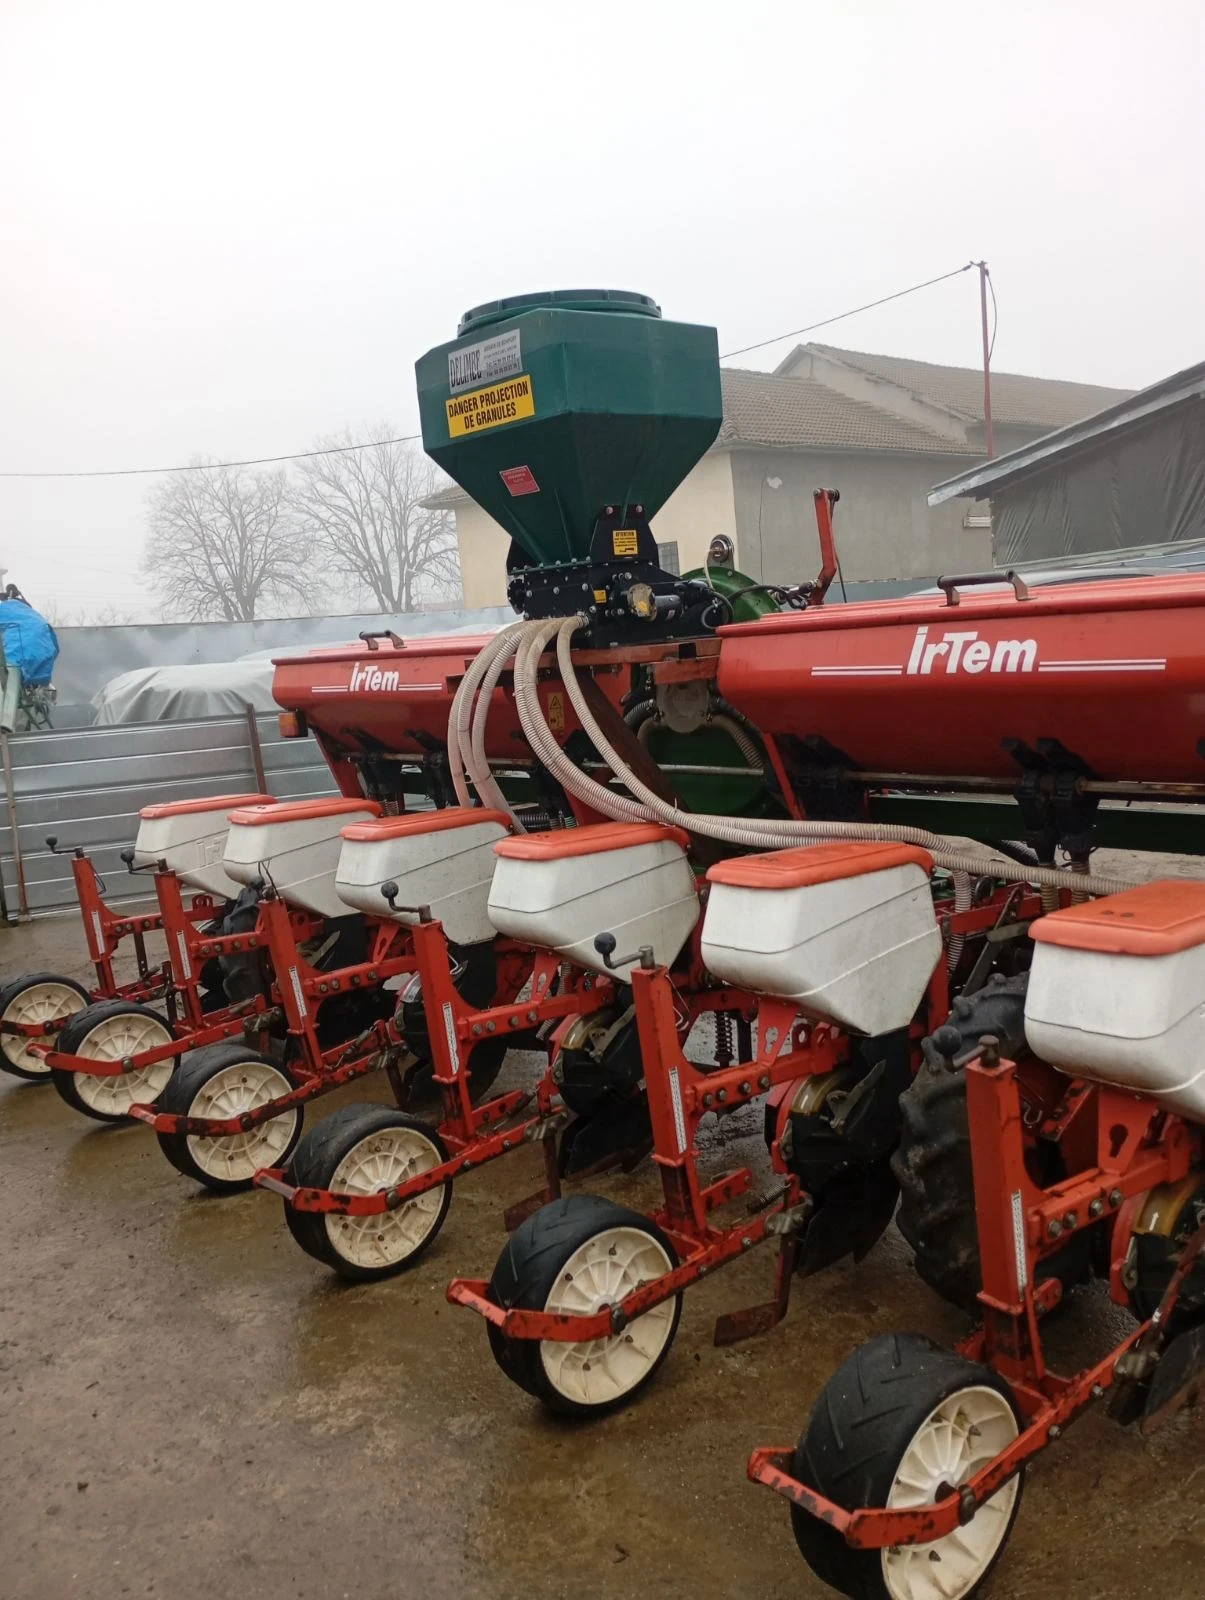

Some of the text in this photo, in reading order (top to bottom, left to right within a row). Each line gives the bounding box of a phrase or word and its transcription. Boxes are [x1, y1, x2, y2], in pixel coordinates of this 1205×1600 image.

[448, 381, 528, 417] DANGER PROJECTION
[464, 402, 516, 429] DE GRANULES
